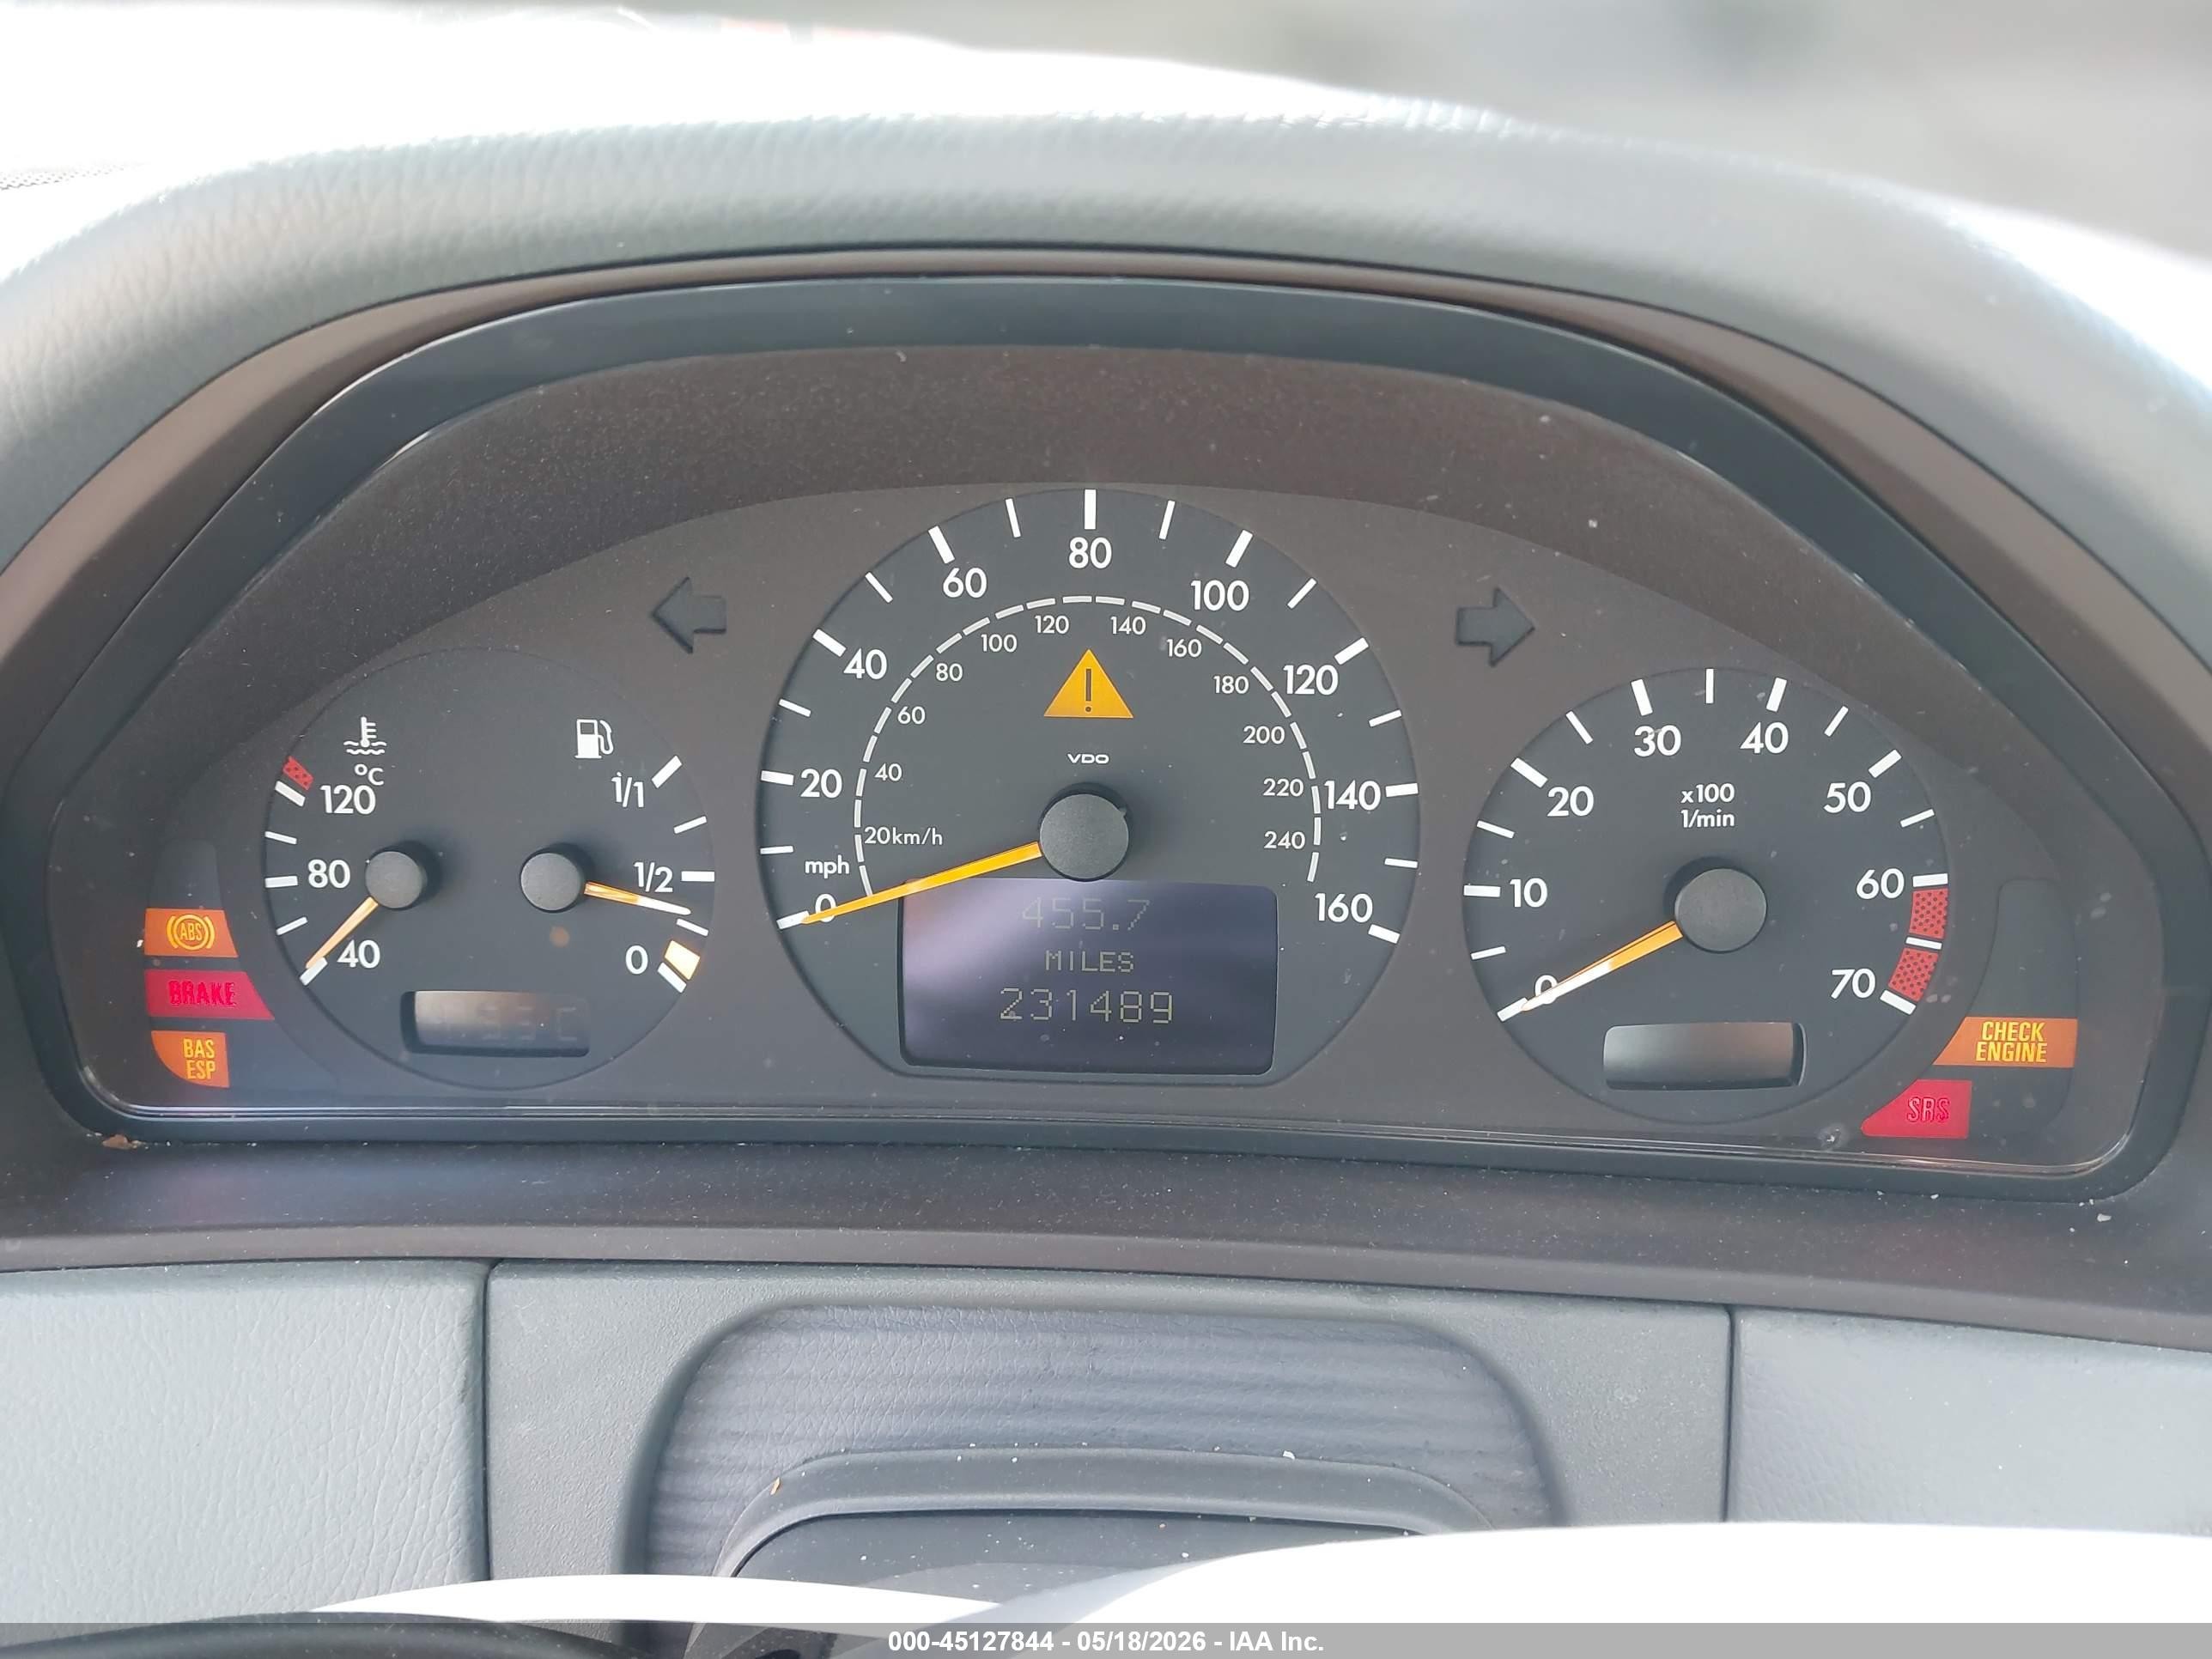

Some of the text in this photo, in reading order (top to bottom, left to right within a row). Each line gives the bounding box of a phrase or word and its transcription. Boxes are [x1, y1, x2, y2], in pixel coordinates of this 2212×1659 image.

[1068, 537, 1112, 569] 80
[943, 566, 988, 599] 60
[1190, 580, 1250, 611] 100
[1034, 615, 1070, 635] 120
[1110, 616, 1147, 635] 140
[981, 634, 1018, 653] 100
[1167, 638, 1202, 658] 160
[843, 647, 888, 680] 40
[935, 663, 963, 683] 80
[1213, 675, 1249, 695] 180
[1282, 664, 1339, 696] 120
[897, 706, 927, 725] 60
[1243, 725, 1286, 744] 200
[1633, 725, 1681, 757] 30
[1740, 721, 1789, 754] 40
[874, 763, 902, 781] 40
[1066, 752, 1110, 765] VDO
[611, 775, 645, 808] 1/1
[799, 769, 842, 799] 20
[1262, 778, 1304, 797] 220
[1324, 780, 1382, 811] 140
[1680, 782, 1735, 804] x100
[1823, 781, 1872, 813] 50
[319, 784, 377, 815] 120
[1547, 786, 1595, 817] 20
[1680, 808, 1735, 828] 1/min
[1263, 830, 1306, 849] 240
[307, 859, 351, 889] 80
[633, 861, 673, 893] 1/2
[804, 857, 850, 879] mph
[1510, 878, 1548, 908] 10
[1856, 868, 1905, 900] 60
[815, 893, 836, 923] 0
[1022, 897, 1151, 931] 455.7
[1315, 891, 1374, 924] 160
[179, 921, 204, 941] ABS
[338, 938, 380, 969] 40
[625, 945, 648, 975] 0
[1045, 950, 1134, 973] MILES
[168, 981, 236, 1006] BRAKE
[1831, 968, 1876, 1000] 70
[1000, 988, 1174, 1024] 231489
[1981, 1021, 2045, 1042] CHECK
[182, 1038, 216, 1059] BAS
[1975, 1042, 2047, 1062] ENGINE
[185, 1060, 216, 1080] ESP
[1906, 1097, 1950, 1122] SRS
